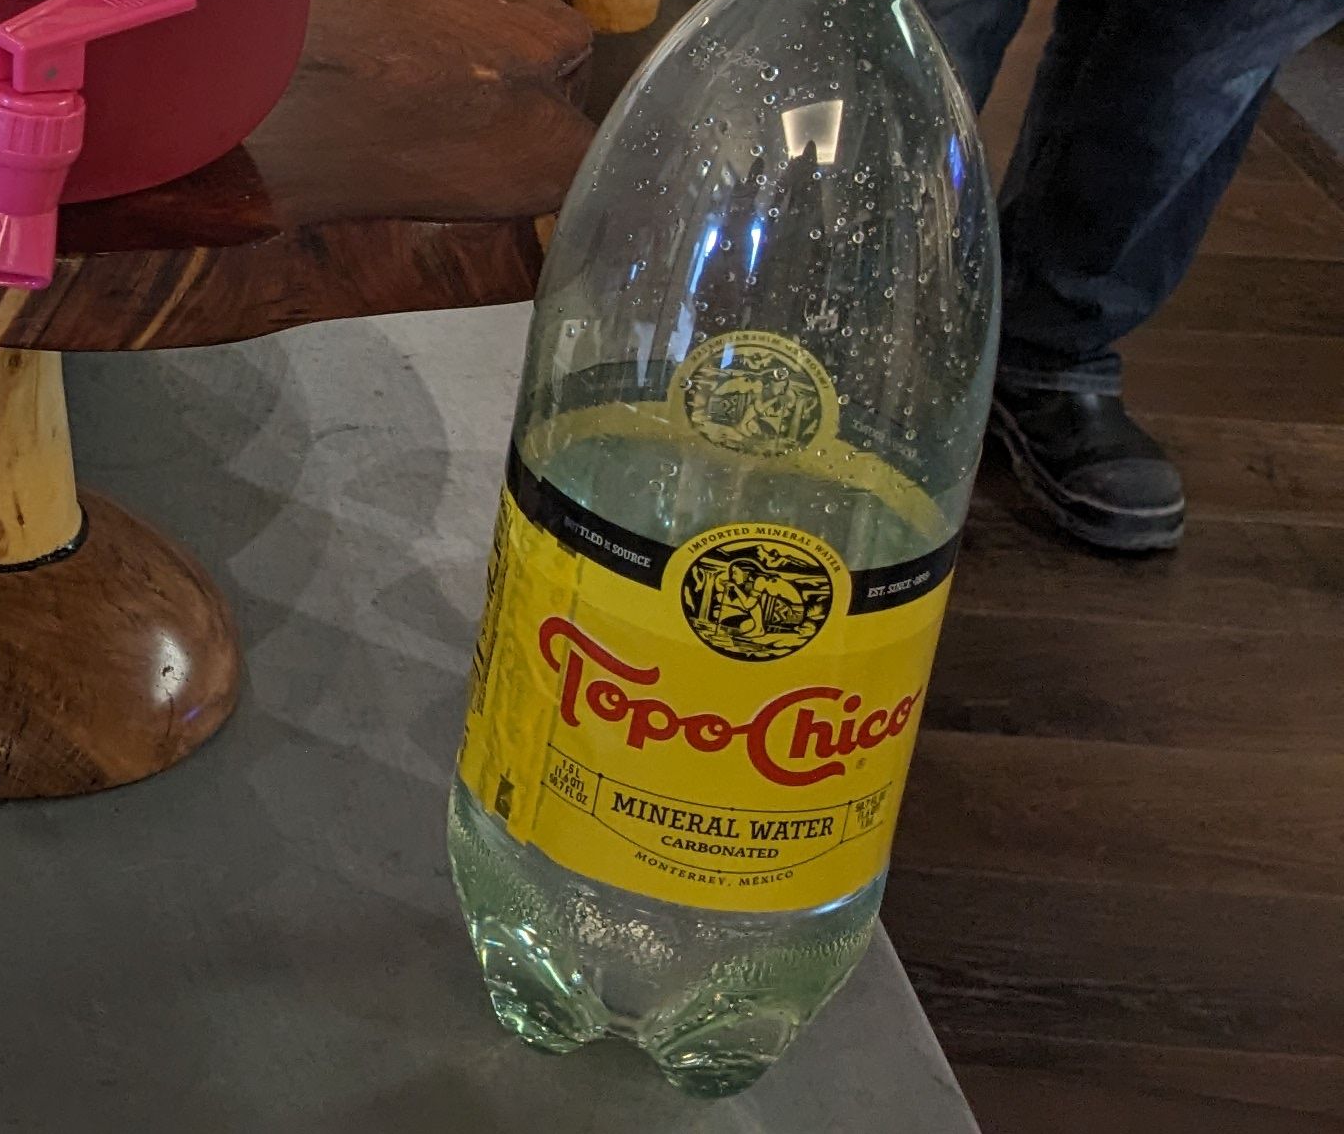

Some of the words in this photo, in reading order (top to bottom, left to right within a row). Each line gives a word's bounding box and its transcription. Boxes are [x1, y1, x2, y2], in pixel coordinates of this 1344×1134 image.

[611, 542, 652, 569] SOURCE
[687, 527, 750, 555] IMPORTED
[755, 526, 812, 546] MINERAL
[813, 544, 842, 574] WATER
[538, 616, 740, 752] Topo
[745, 686, 924, 786] Chico
[611, 791, 739, 839] MINERAL
[750, 816, 834, 841] WATER
[661, 835, 779, 859] CARBONATED
